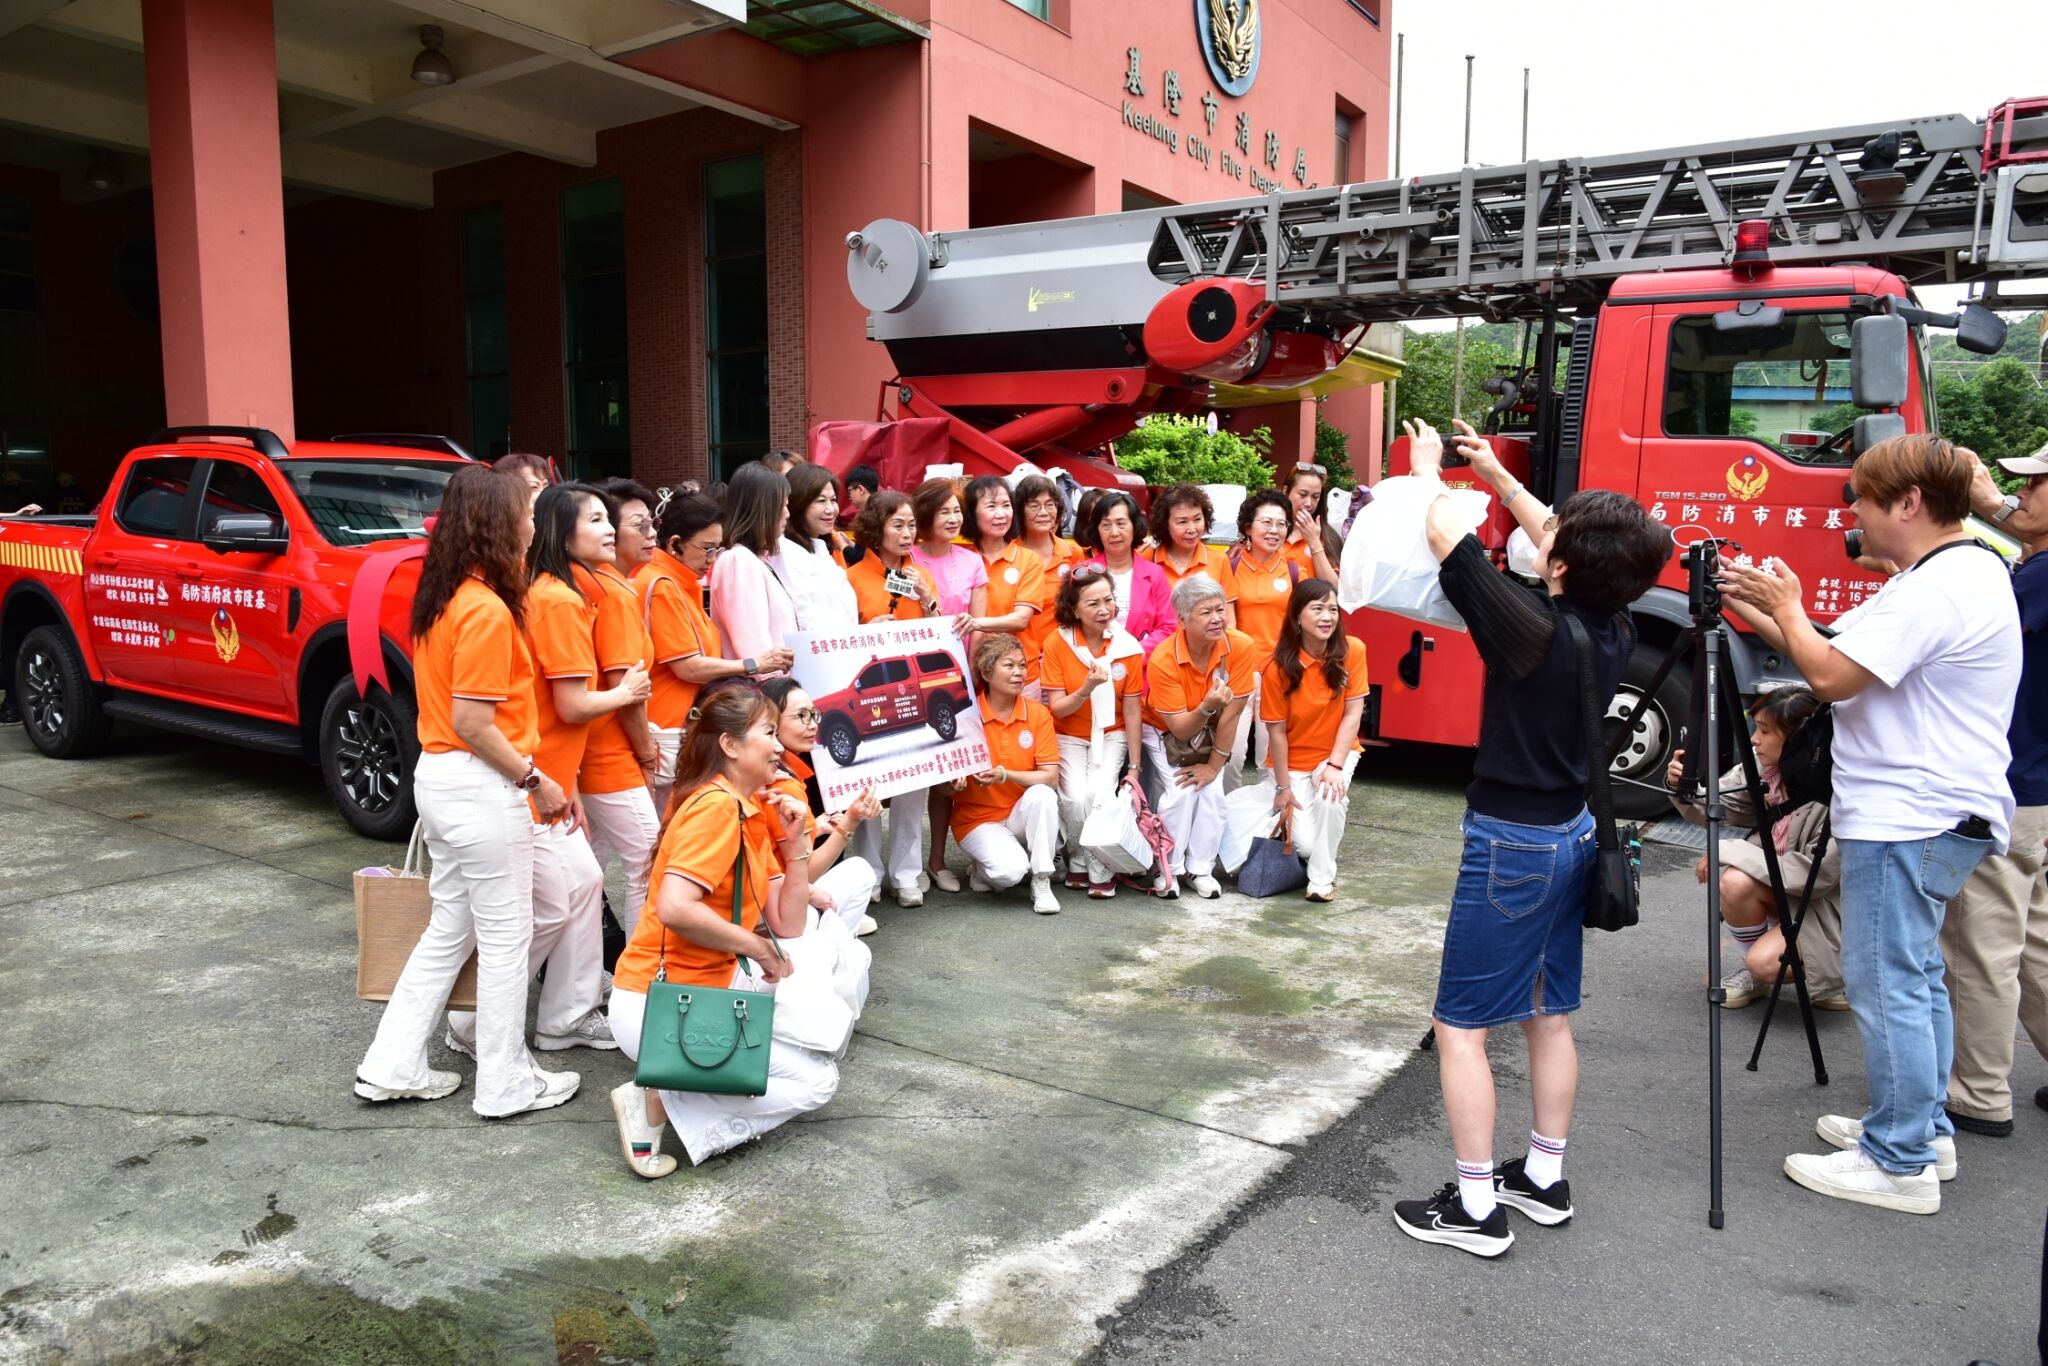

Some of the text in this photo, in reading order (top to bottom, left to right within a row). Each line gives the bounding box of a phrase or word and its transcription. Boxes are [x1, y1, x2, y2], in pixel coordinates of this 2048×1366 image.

[1123, 47, 1308, 185] 基隆市消防局
[1122, 99, 1178, 154] Keelung
[1186, 134, 1213, 169] City
[1220, 151, 1244, 181] Fire
[1653, 491, 1728, 501] TGM 15.290
[1848, 580, 1884, 591] AAE-053
[1849, 591, 1862, 602] 16
